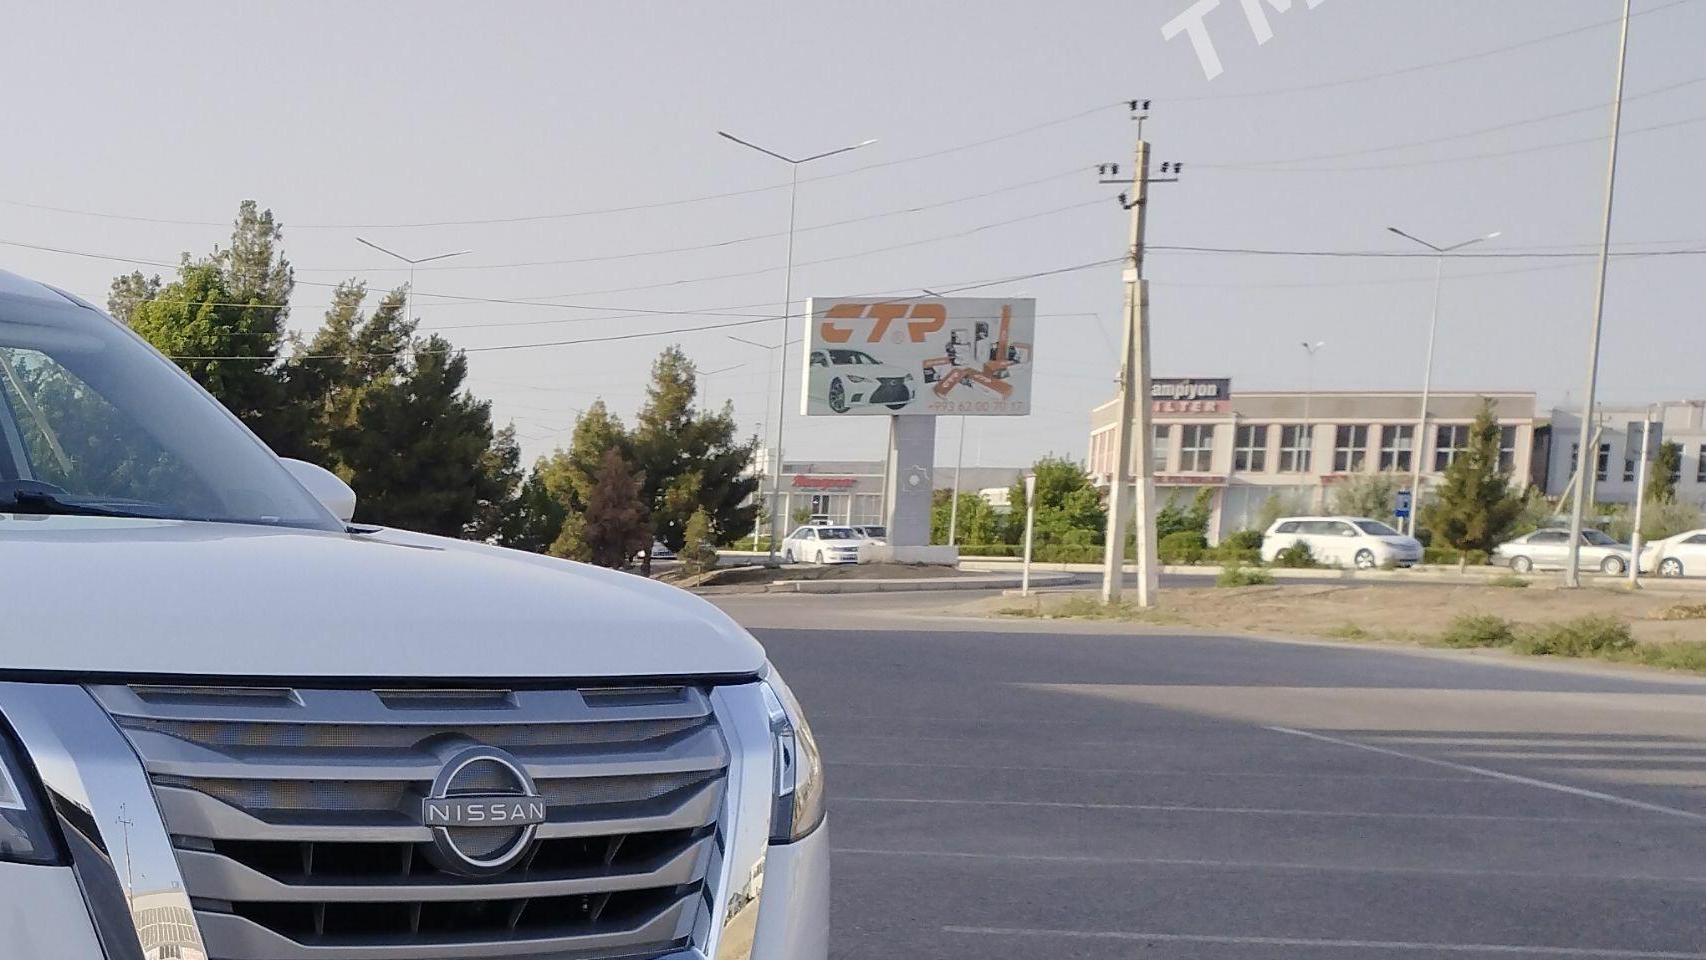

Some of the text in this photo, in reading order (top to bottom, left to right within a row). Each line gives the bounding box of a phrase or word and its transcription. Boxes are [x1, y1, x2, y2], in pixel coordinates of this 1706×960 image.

[1152, 380, 1218, 400] ampiyon
[1153, 401, 1216, 412] ILTER
[429, 803, 544, 821] NISSAN
